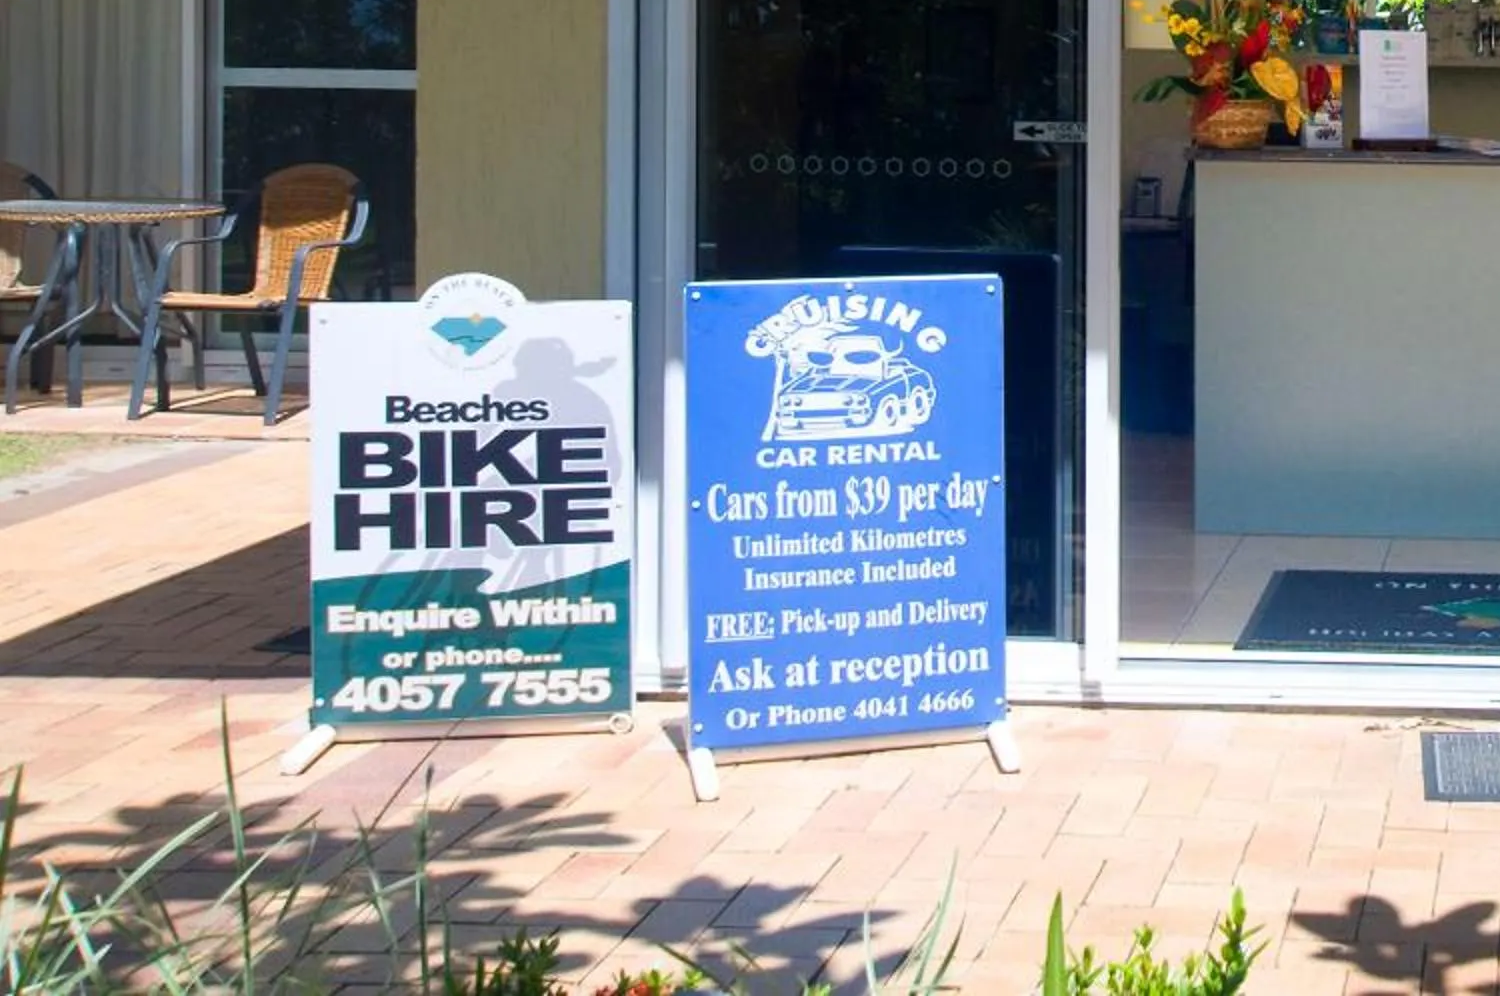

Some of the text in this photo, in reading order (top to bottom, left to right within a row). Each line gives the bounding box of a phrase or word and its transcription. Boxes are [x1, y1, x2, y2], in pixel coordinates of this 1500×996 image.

[744, 295, 949, 358] CRUISING
[386, 394, 549, 424] Beaches
[339, 426, 610, 490] BIKE
[755, 440, 942, 470] CAR RENTAL
[334, 486, 615, 552] HIRE
[707, 472, 989, 523] Cars from $39 per day
[733, 526, 967, 561] Unlimited Kilometres
[743, 556, 957, 592] Insurance Included
[327, 598, 617, 638] Enquire Within
[705, 597, 990, 641] FREE: Pick-up and Delivery
[383, 650, 417, 670] or
[708, 642, 991, 694] Ask at reception
[331, 667, 612, 713] 4057 7555
[725, 687, 975, 731] Or Phone 4041 4666
